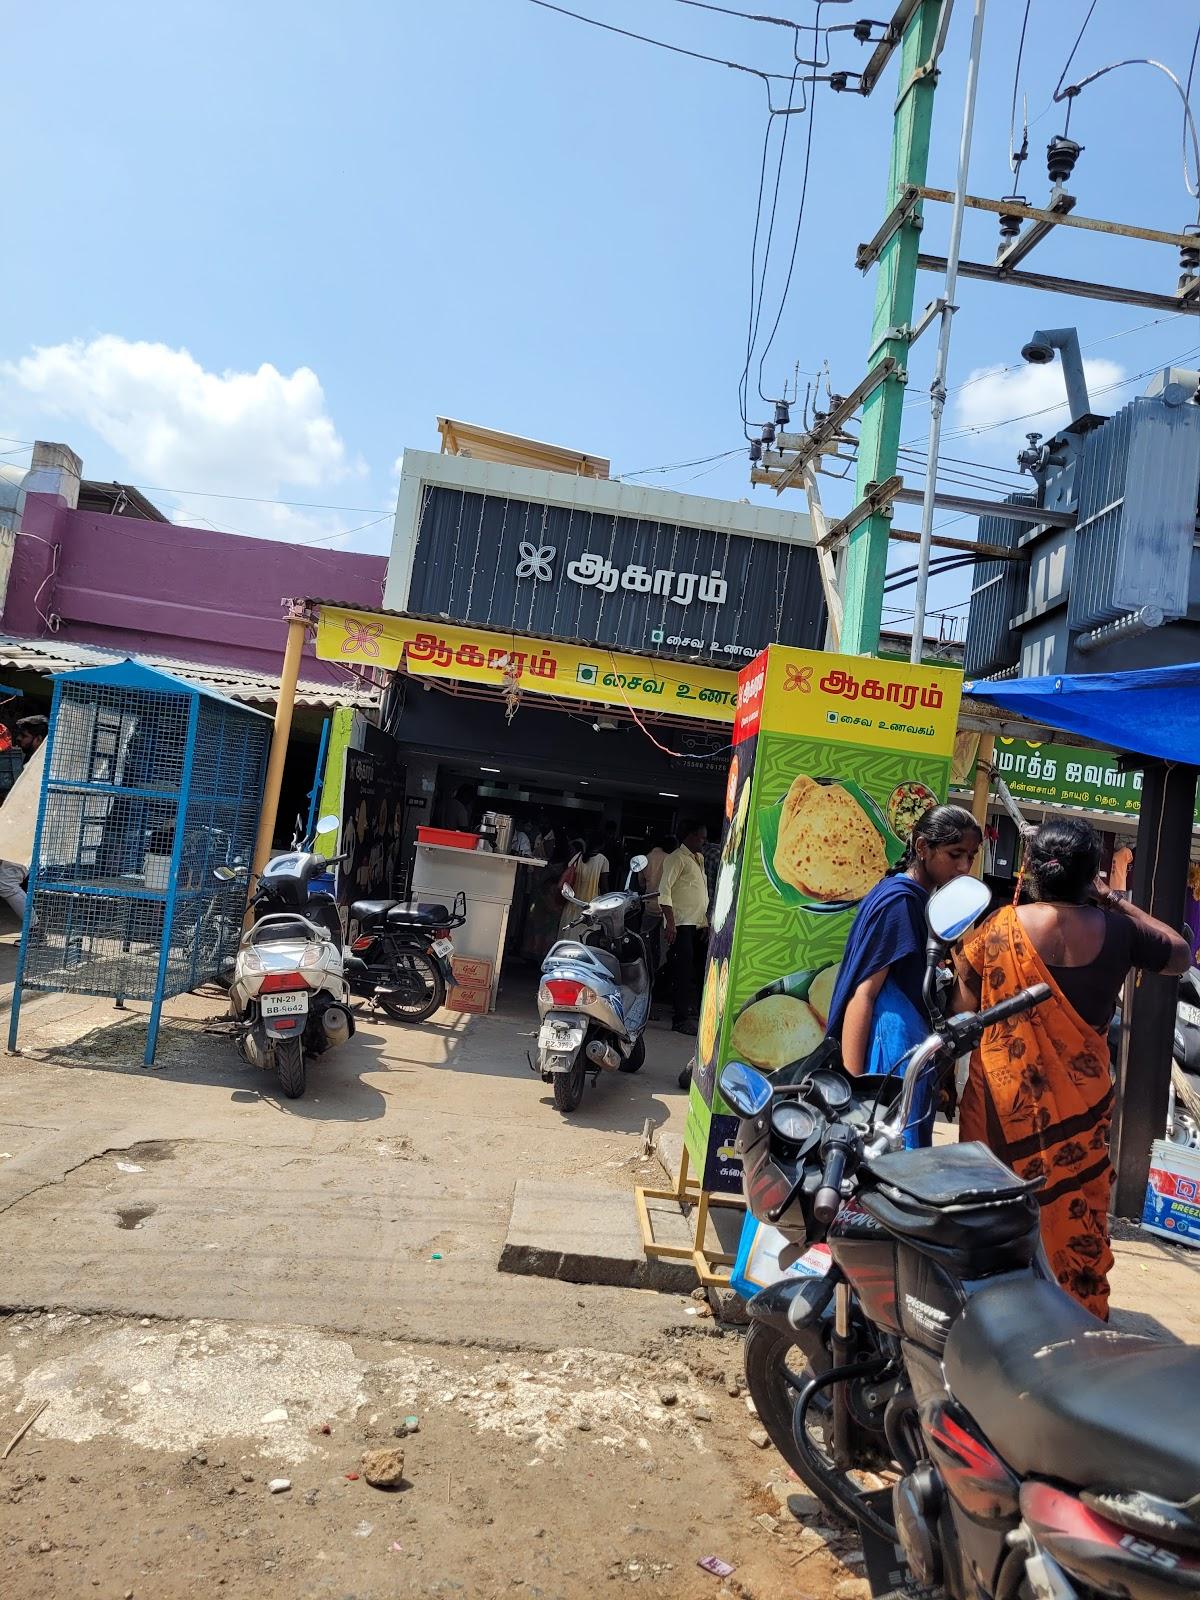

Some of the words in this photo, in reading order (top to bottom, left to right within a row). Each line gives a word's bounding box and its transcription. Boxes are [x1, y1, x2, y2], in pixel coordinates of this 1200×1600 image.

[566, 551, 729, 606] ஆகாரம்
[666, 635, 705, 649] சைவ
[404, 632, 557, 680] ஆகாரம்
[602, 671, 665, 695] சைவ
[819, 669, 944, 711] ஆகாரம்
[840, 714, 872, 728] சைவ
[878, 719, 936, 737] உணவகம்
[270, 995, 296, 1004] TN-29
[1171, 1202, 1200, 1219] BREEZ
[1119, 1533, 1180, 1570] 125
